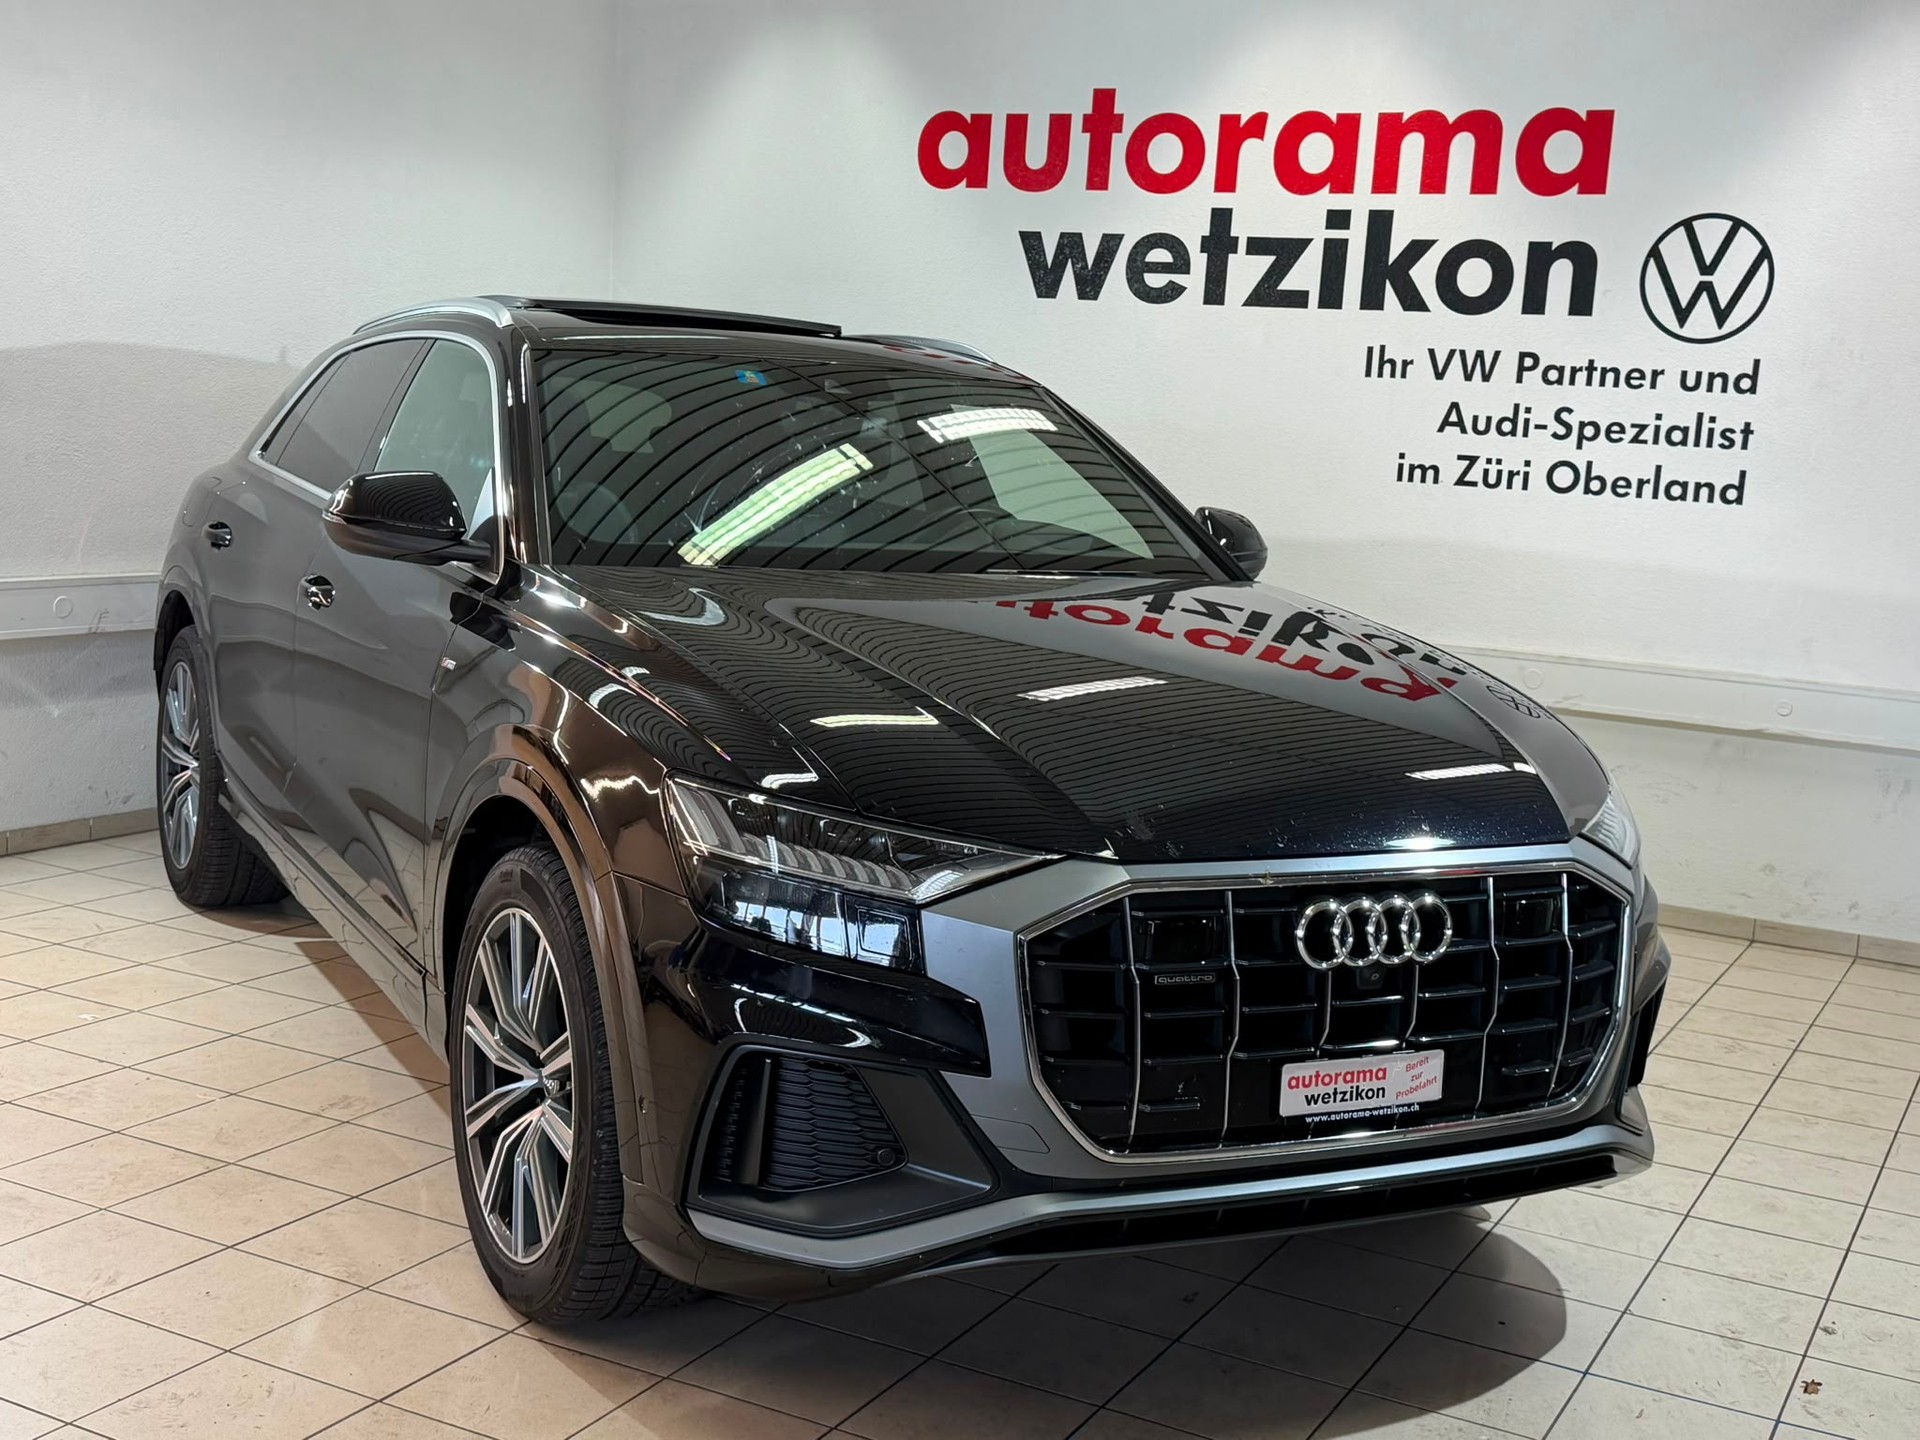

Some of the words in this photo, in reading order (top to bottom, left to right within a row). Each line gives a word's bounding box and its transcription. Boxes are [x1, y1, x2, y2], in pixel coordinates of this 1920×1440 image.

[917, 88, 1615, 197] autorama
[1018, 207, 1598, 317] wetzikon
[1364, 344, 1414, 379] Ihr
[1427, 348, 1502, 383] VW
[1515, 351, 1665, 390] Partner
[1679, 358, 1761, 395] und
[1436, 401, 1755, 451] Audi-Spezialist
[1396, 452, 1440, 485] im
[1453, 454, 1532, 491] Züri
[1546, 460, 1747, 506] Oberland
[1157, 974, 1213, 986] quattro
[1405, 1056, 1430, 1073] Bereit
[1410, 1070, 1425, 1083] zur
[1287, 1066, 1388, 1091] autorama
[1395, 1075, 1438, 1101] Probefahrt
[1304, 1085, 1386, 1107] wetzikon
[1304, 1102, 1420, 1124] www.autorama-wetzikon.ch
